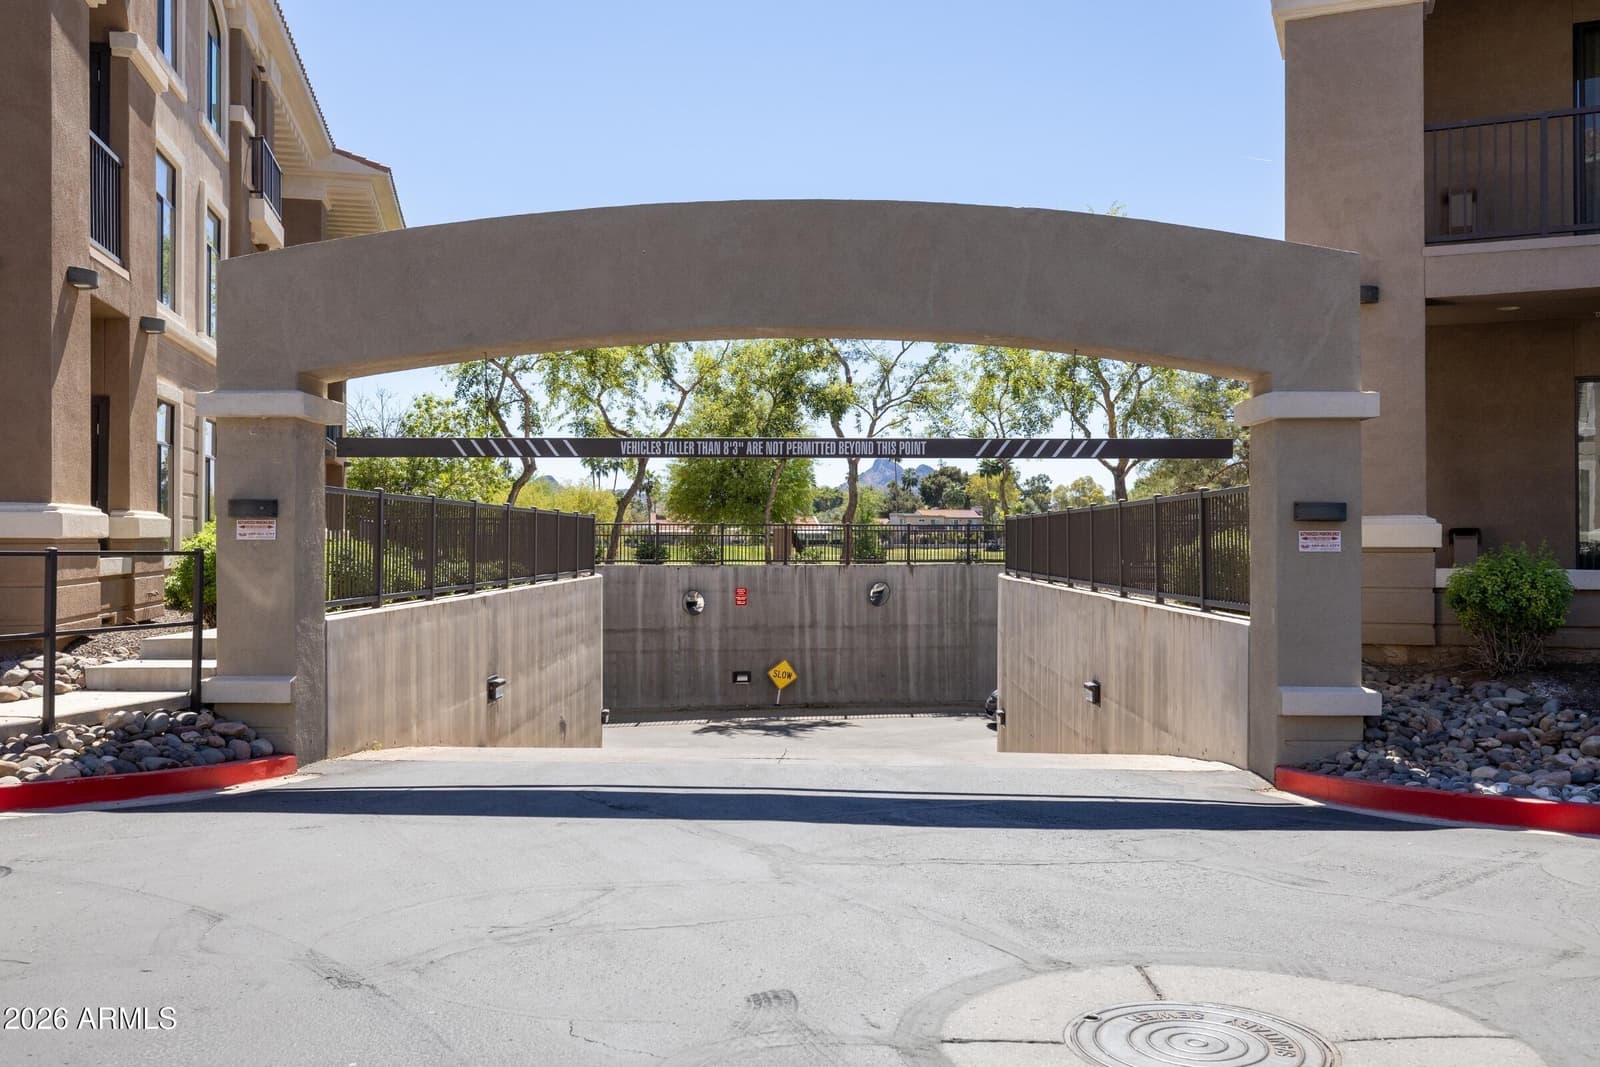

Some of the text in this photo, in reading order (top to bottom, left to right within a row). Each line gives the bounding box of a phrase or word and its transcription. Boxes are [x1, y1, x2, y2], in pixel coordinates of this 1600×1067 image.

[621, 440, 927, 455] VEHICLES TALLER THAN 8'3" ARE NOT PERMITTED BEYOND THIS POINT
[772, 669, 793, 680] SLOW
[1126, 1010, 1297, 1059] SANITARY SEWER
